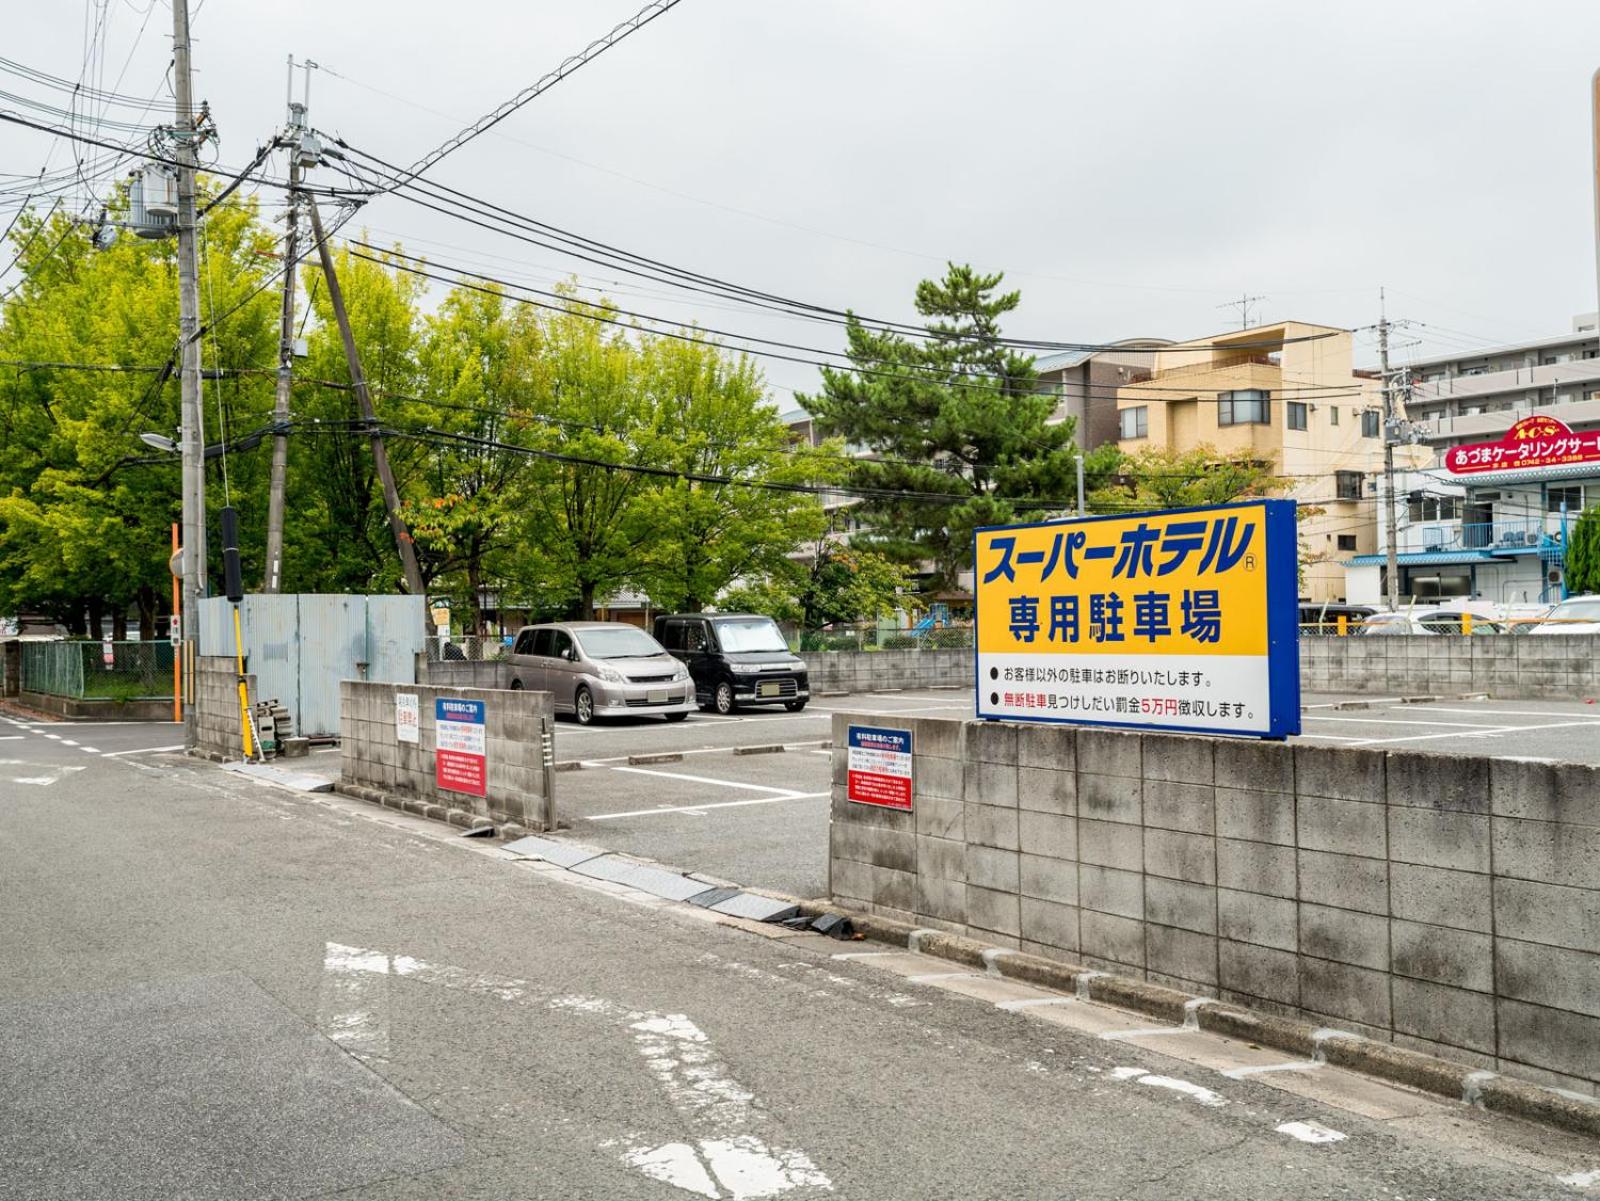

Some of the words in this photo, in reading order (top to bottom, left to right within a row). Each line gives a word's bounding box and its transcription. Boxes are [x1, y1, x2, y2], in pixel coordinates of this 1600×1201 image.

[1455, 436, 1600, 465] あづまケータリングサー
[983, 516, 1256, 584] スーパーホテル
[1008, 589, 1222, 644] 専用駐車場
[1003, 667, 1212, 688] お客様以外の駐車はお断りいたします。
[1003, 691, 1255, 720] 無断駐車見つけしだい罰金5万円徴収します。
